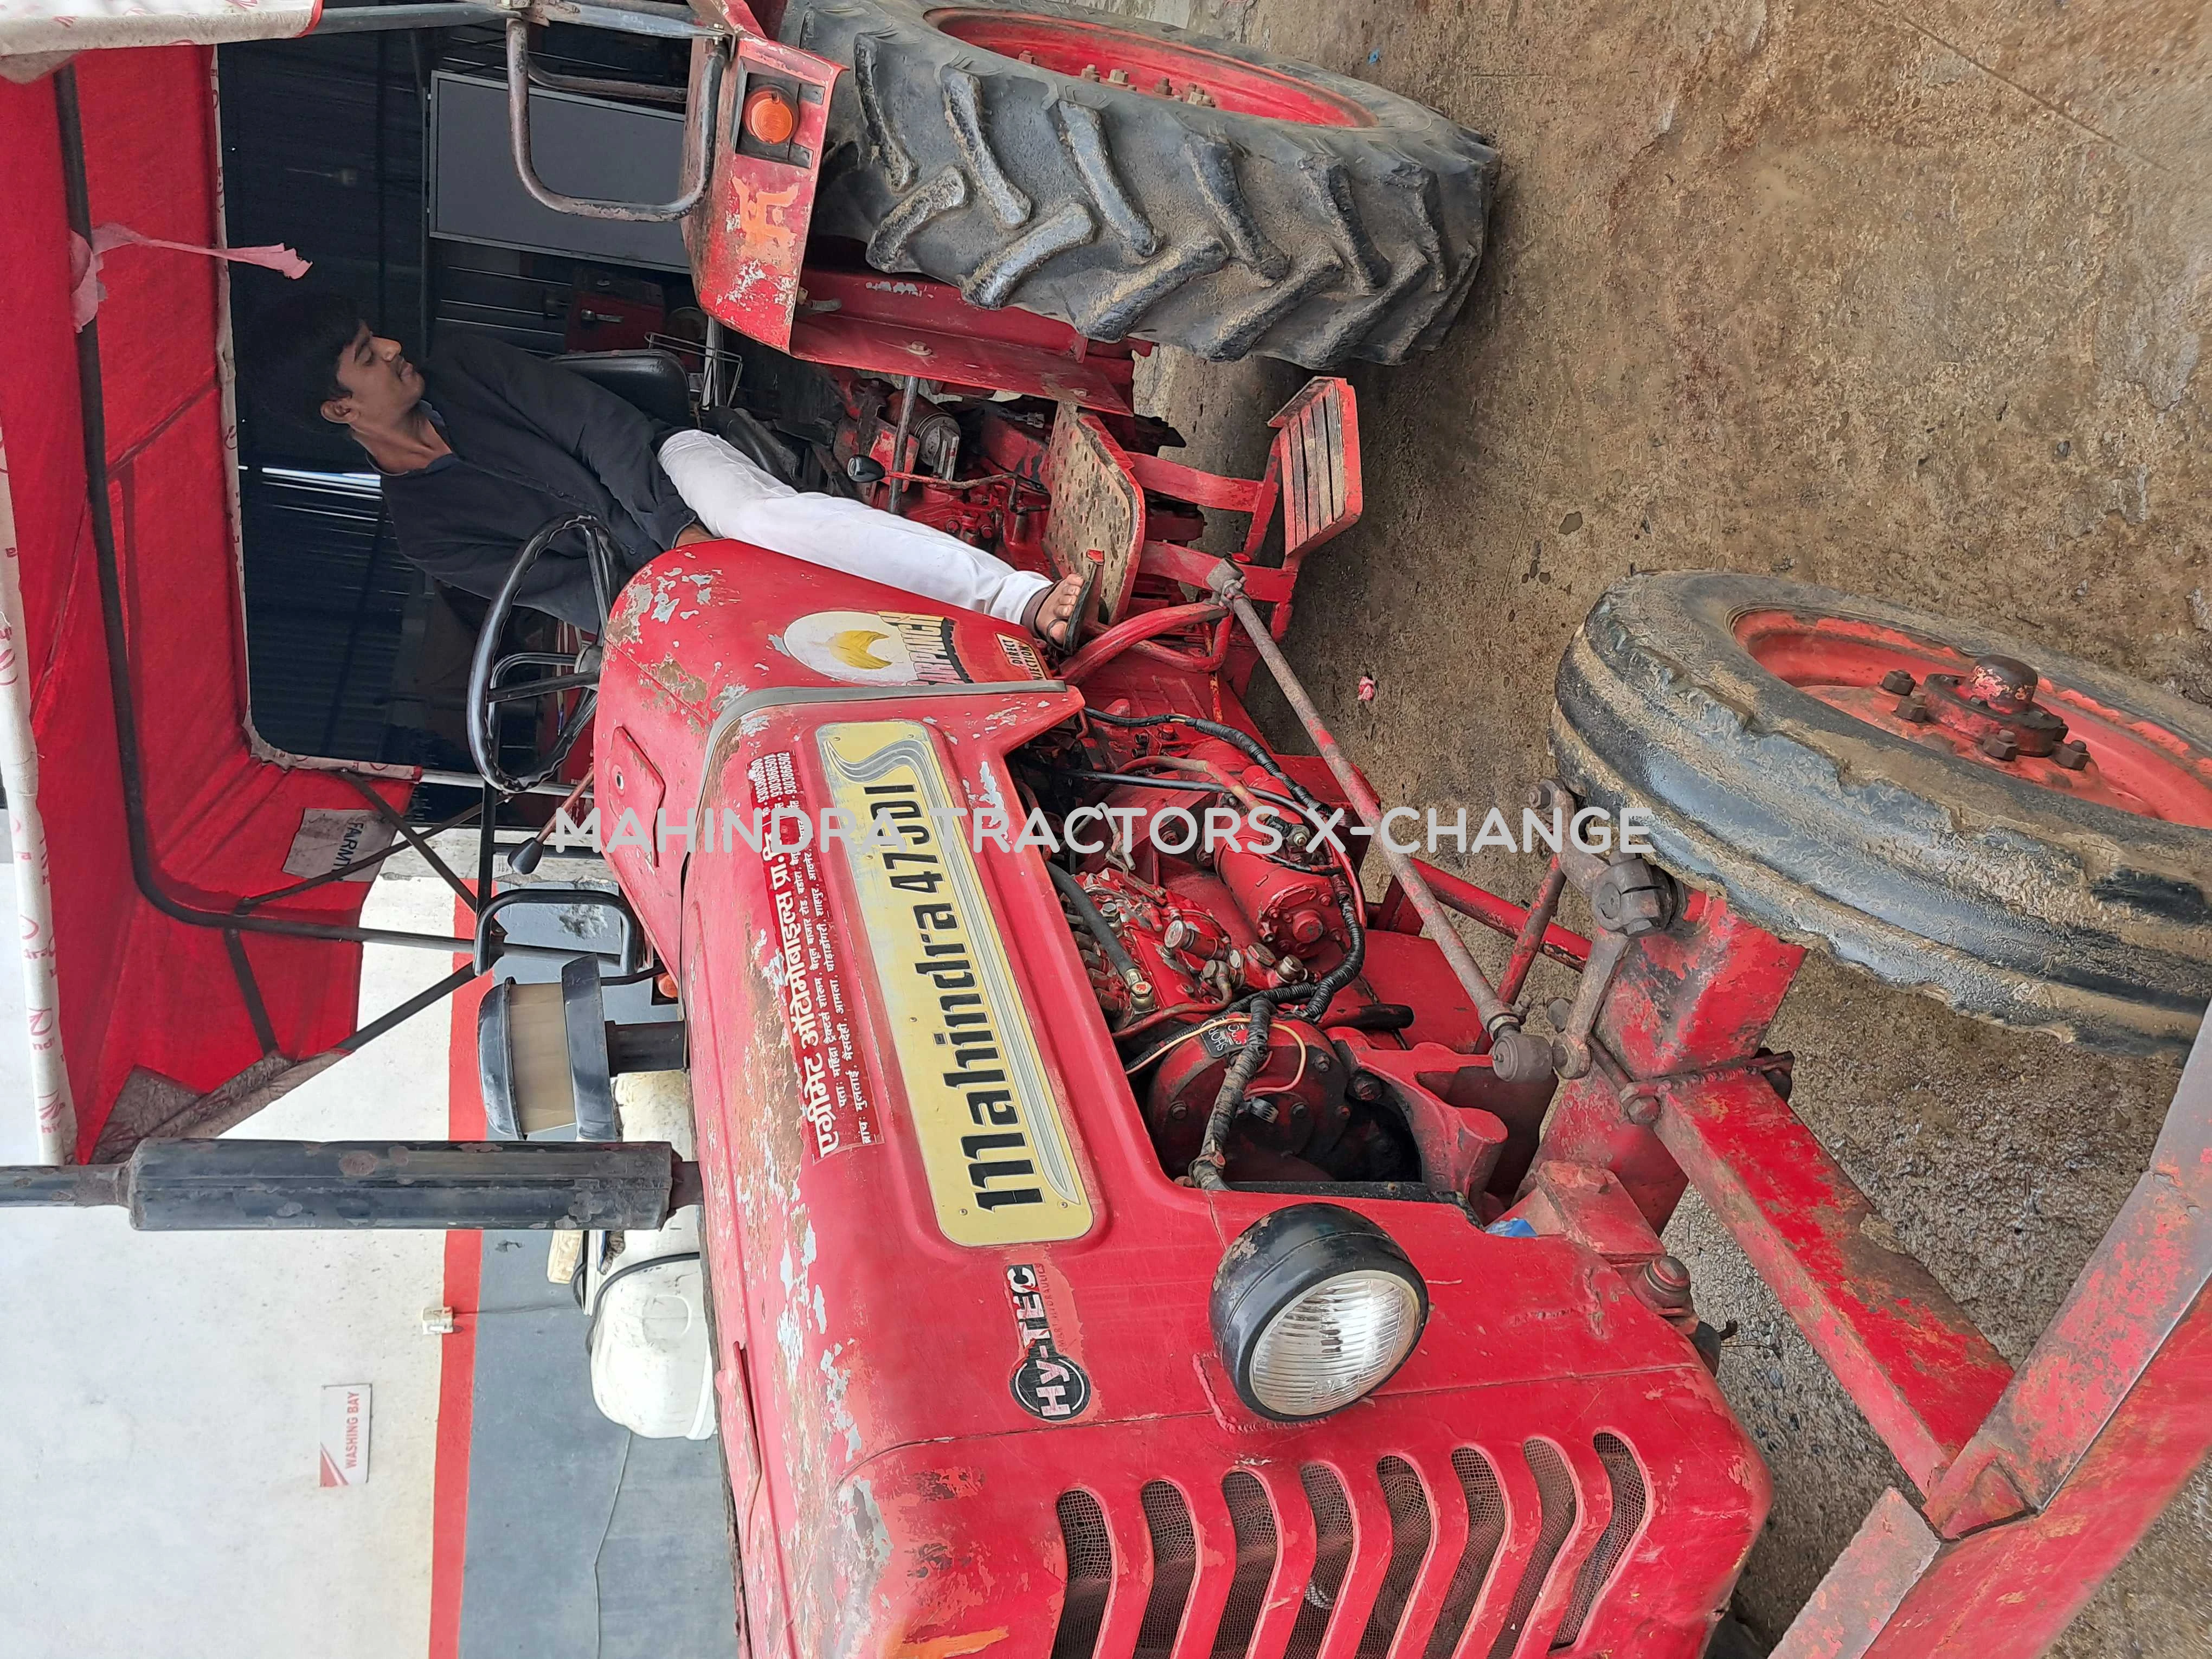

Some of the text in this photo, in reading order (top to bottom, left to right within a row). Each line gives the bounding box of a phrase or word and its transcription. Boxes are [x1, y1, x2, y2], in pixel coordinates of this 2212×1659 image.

[1002, 639, 1023, 664] DIRECT
[1020, 645, 1043, 680] NJECTION
[751, 758, 769, 803] 9303866500
[763, 754, 783, 797] 9303866501
[777, 752, 798, 794] 9303866502
[330, 823, 364, 875] FARMT
[803, 918, 814, 946] बाजार
[775, 891, 819, 1049] ऑटोमोबाइल्स
[803, 1052, 839, 1158] एग्रीमेट
[345, 1392, 359, 1469] WASHING BAY
